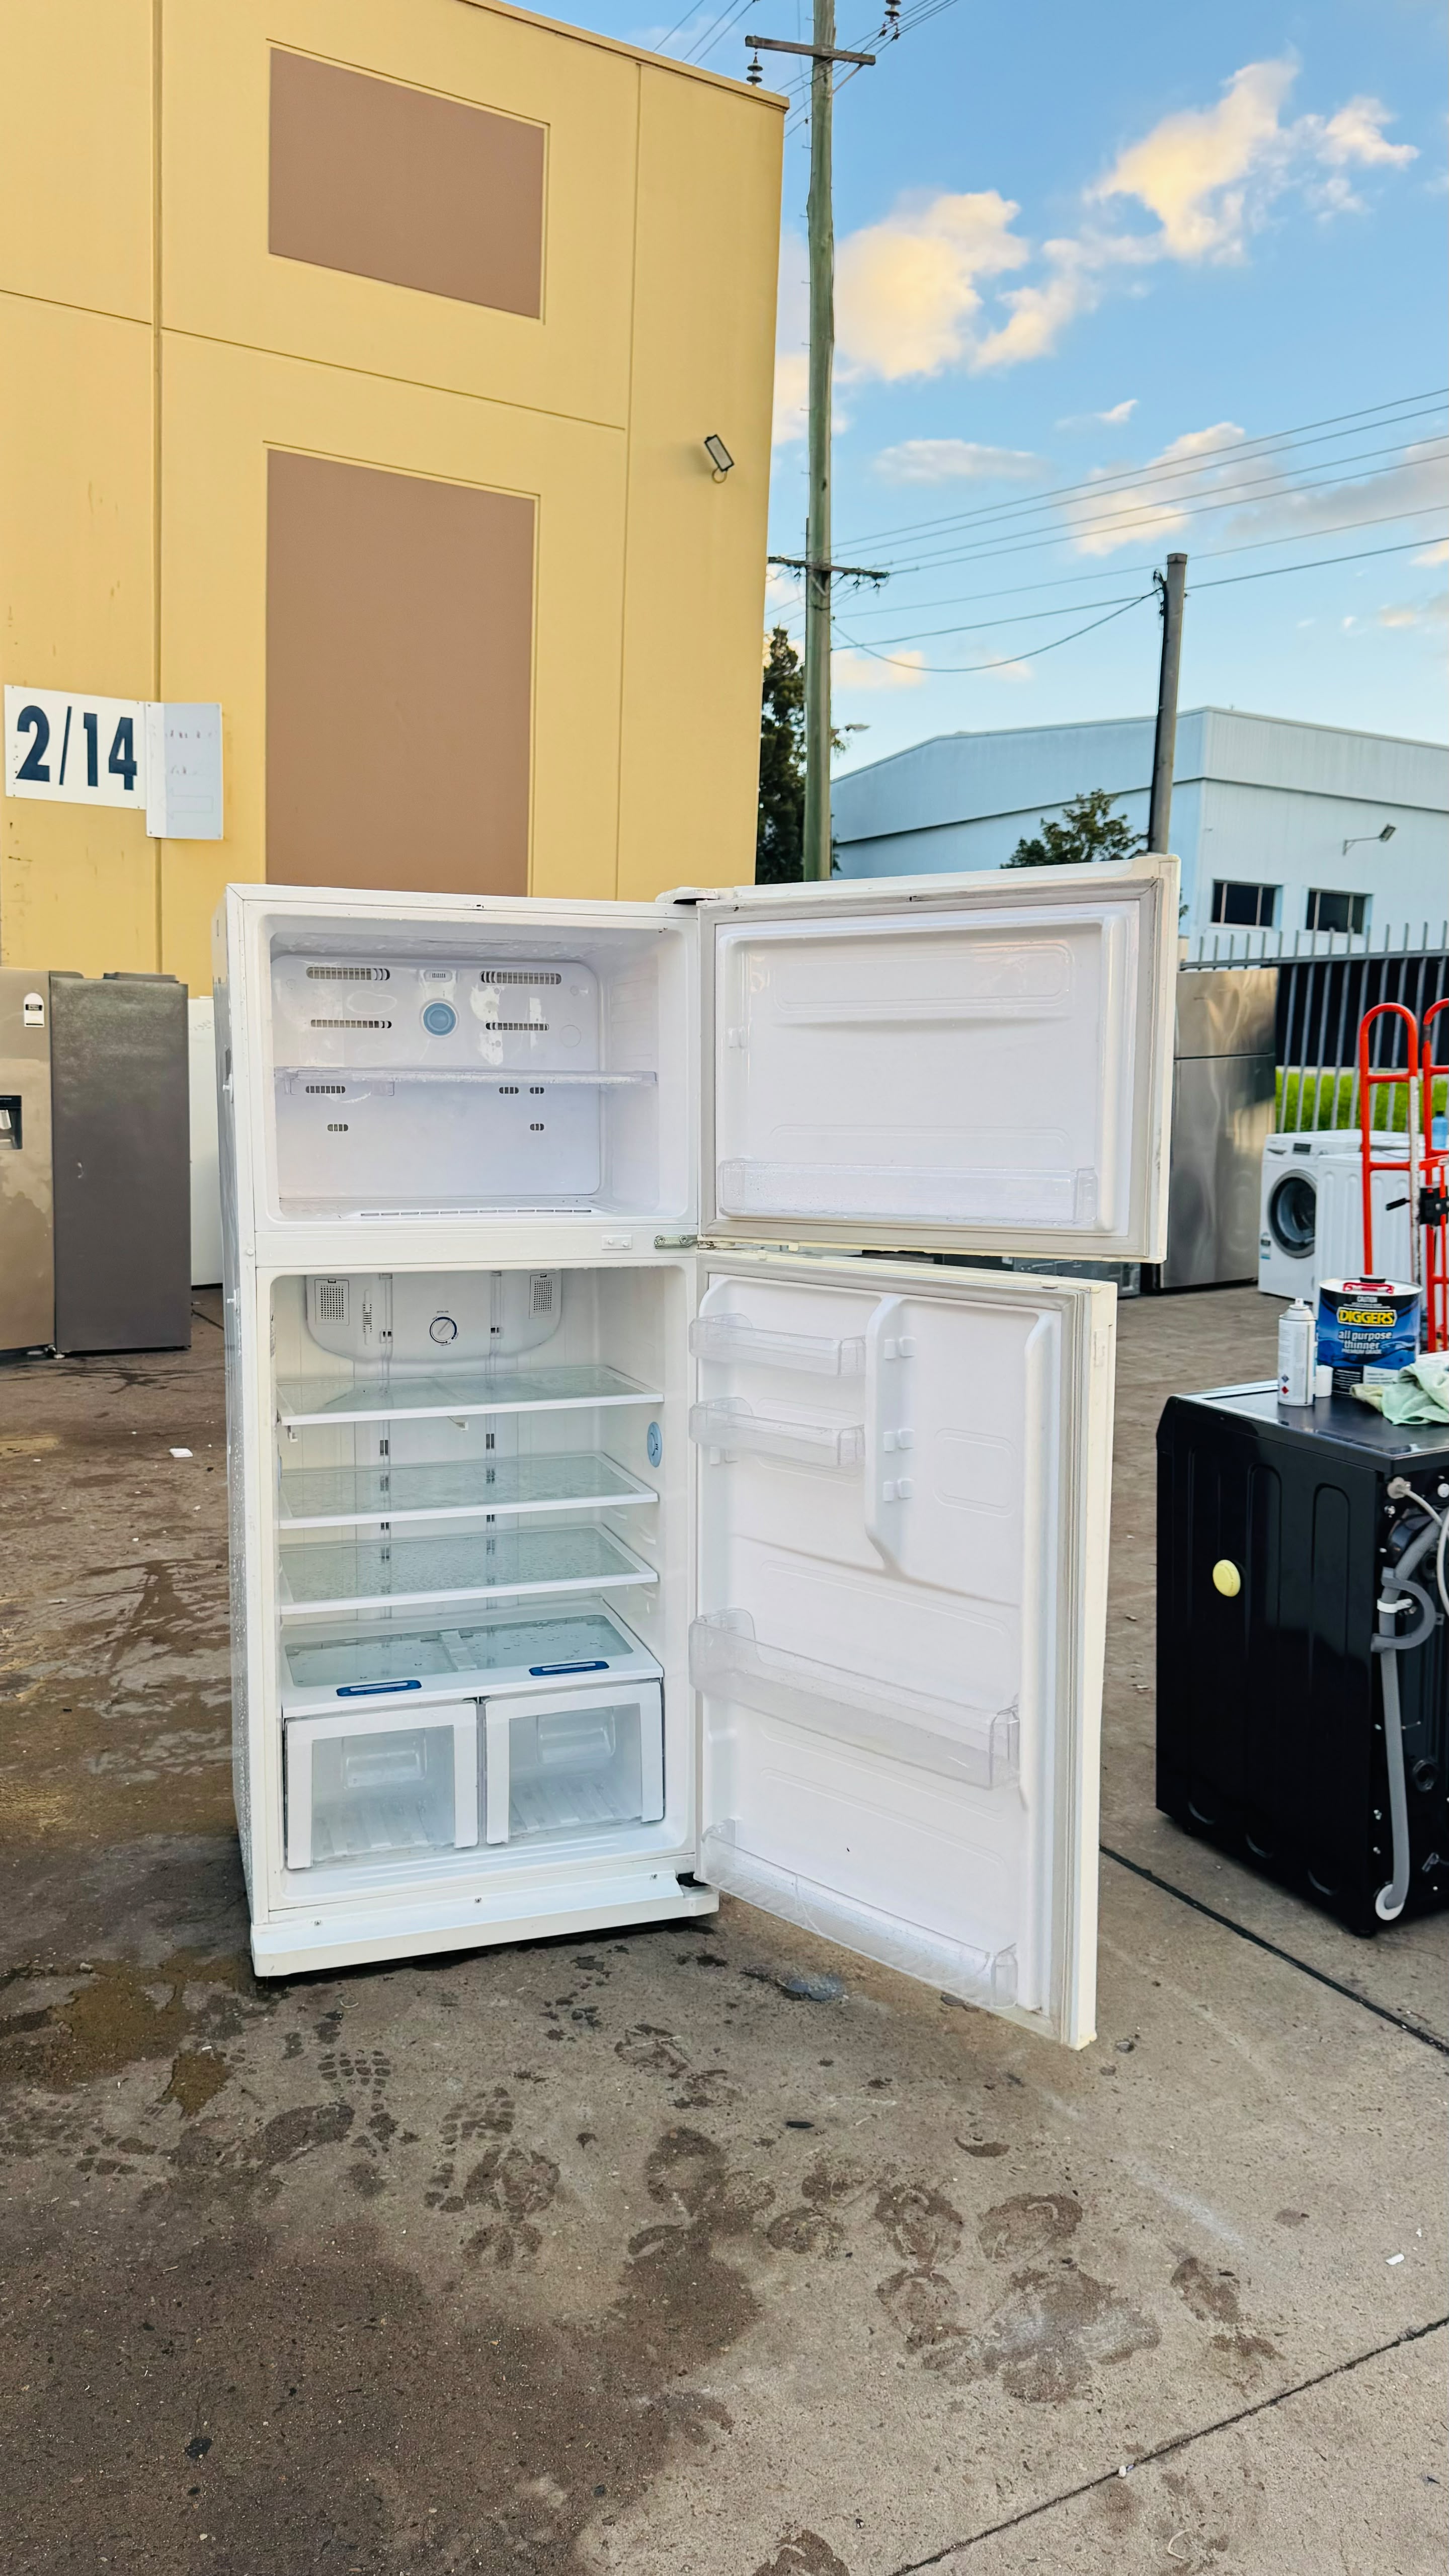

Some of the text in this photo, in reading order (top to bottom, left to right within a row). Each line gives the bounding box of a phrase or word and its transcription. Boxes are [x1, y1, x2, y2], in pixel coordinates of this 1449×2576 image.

[16, 705, 137, 790] 2/14
[1339, 1310, 1394, 1325] DIGGERS
[1338, 1330, 1392, 1342] all purpose
[1344, 1339, 1380, 1349] thinner
